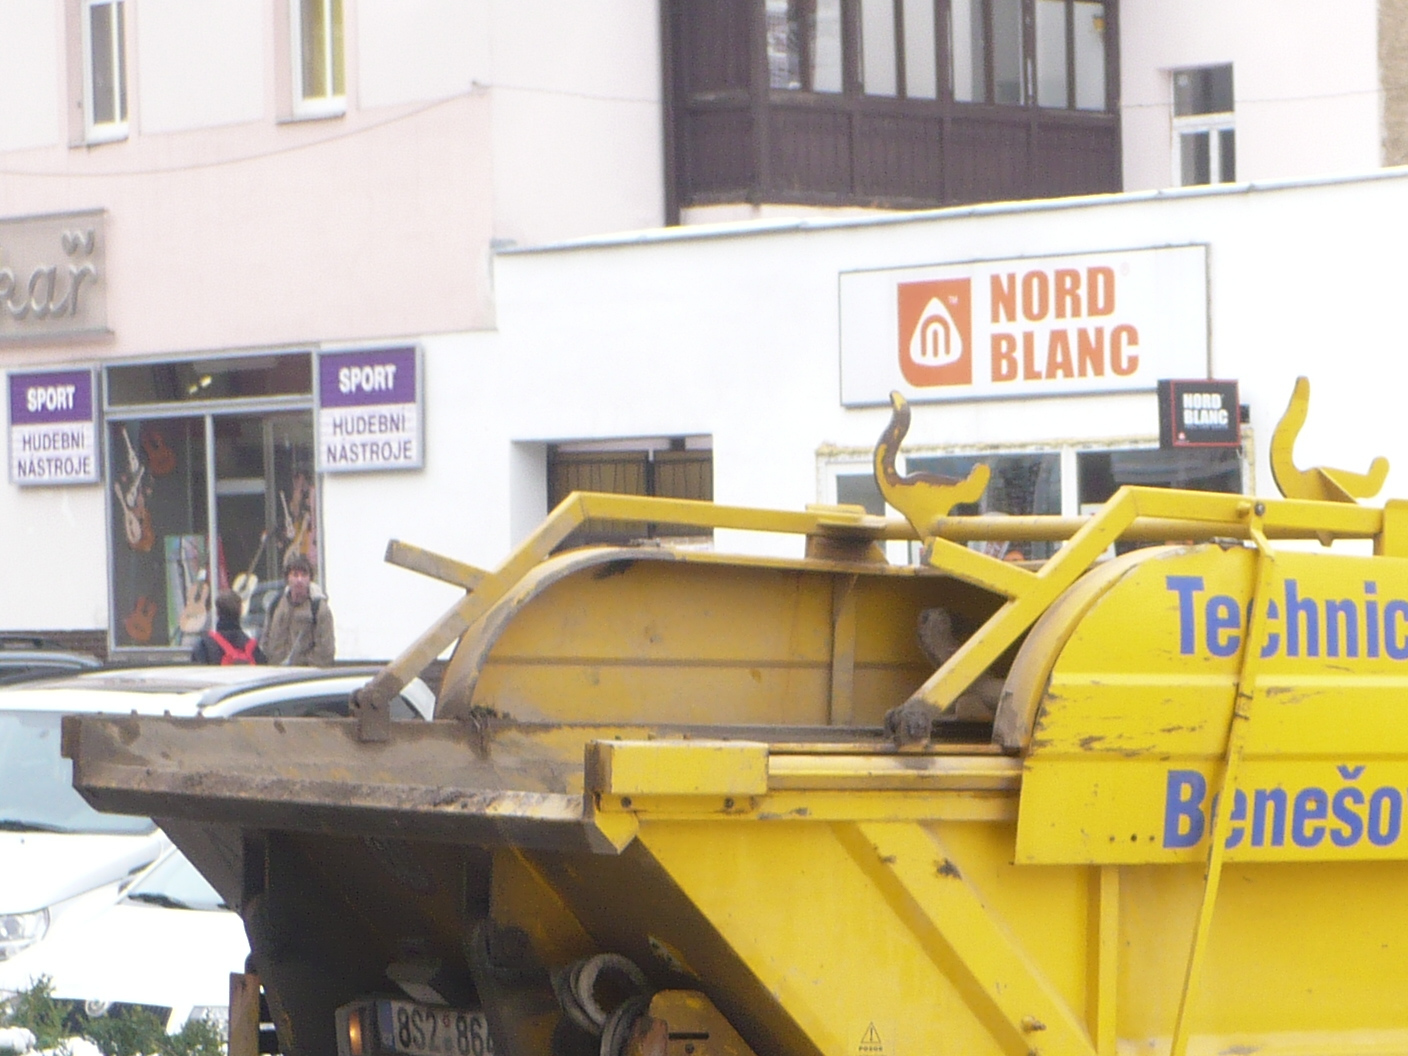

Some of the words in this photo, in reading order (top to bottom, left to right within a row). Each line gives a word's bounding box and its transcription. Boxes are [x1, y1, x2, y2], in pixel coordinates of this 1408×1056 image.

[990, 266, 1115, 324] NORD
[990, 324, 1139, 382] BLANC
[338, 363, 397, 394] SPORT
[27, 384, 76, 413] SPORT
[1183, 393, 1222, 409] NORD
[332, 407, 406, 436] HUDEBNÍ
[1183, 409, 1229, 425] BLANC
[22, 426, 85, 452] HUDEBNÍ
[326, 437, 413, 463] NÁSTROJE
[17, 454, 91, 477] NÁSTROJE
